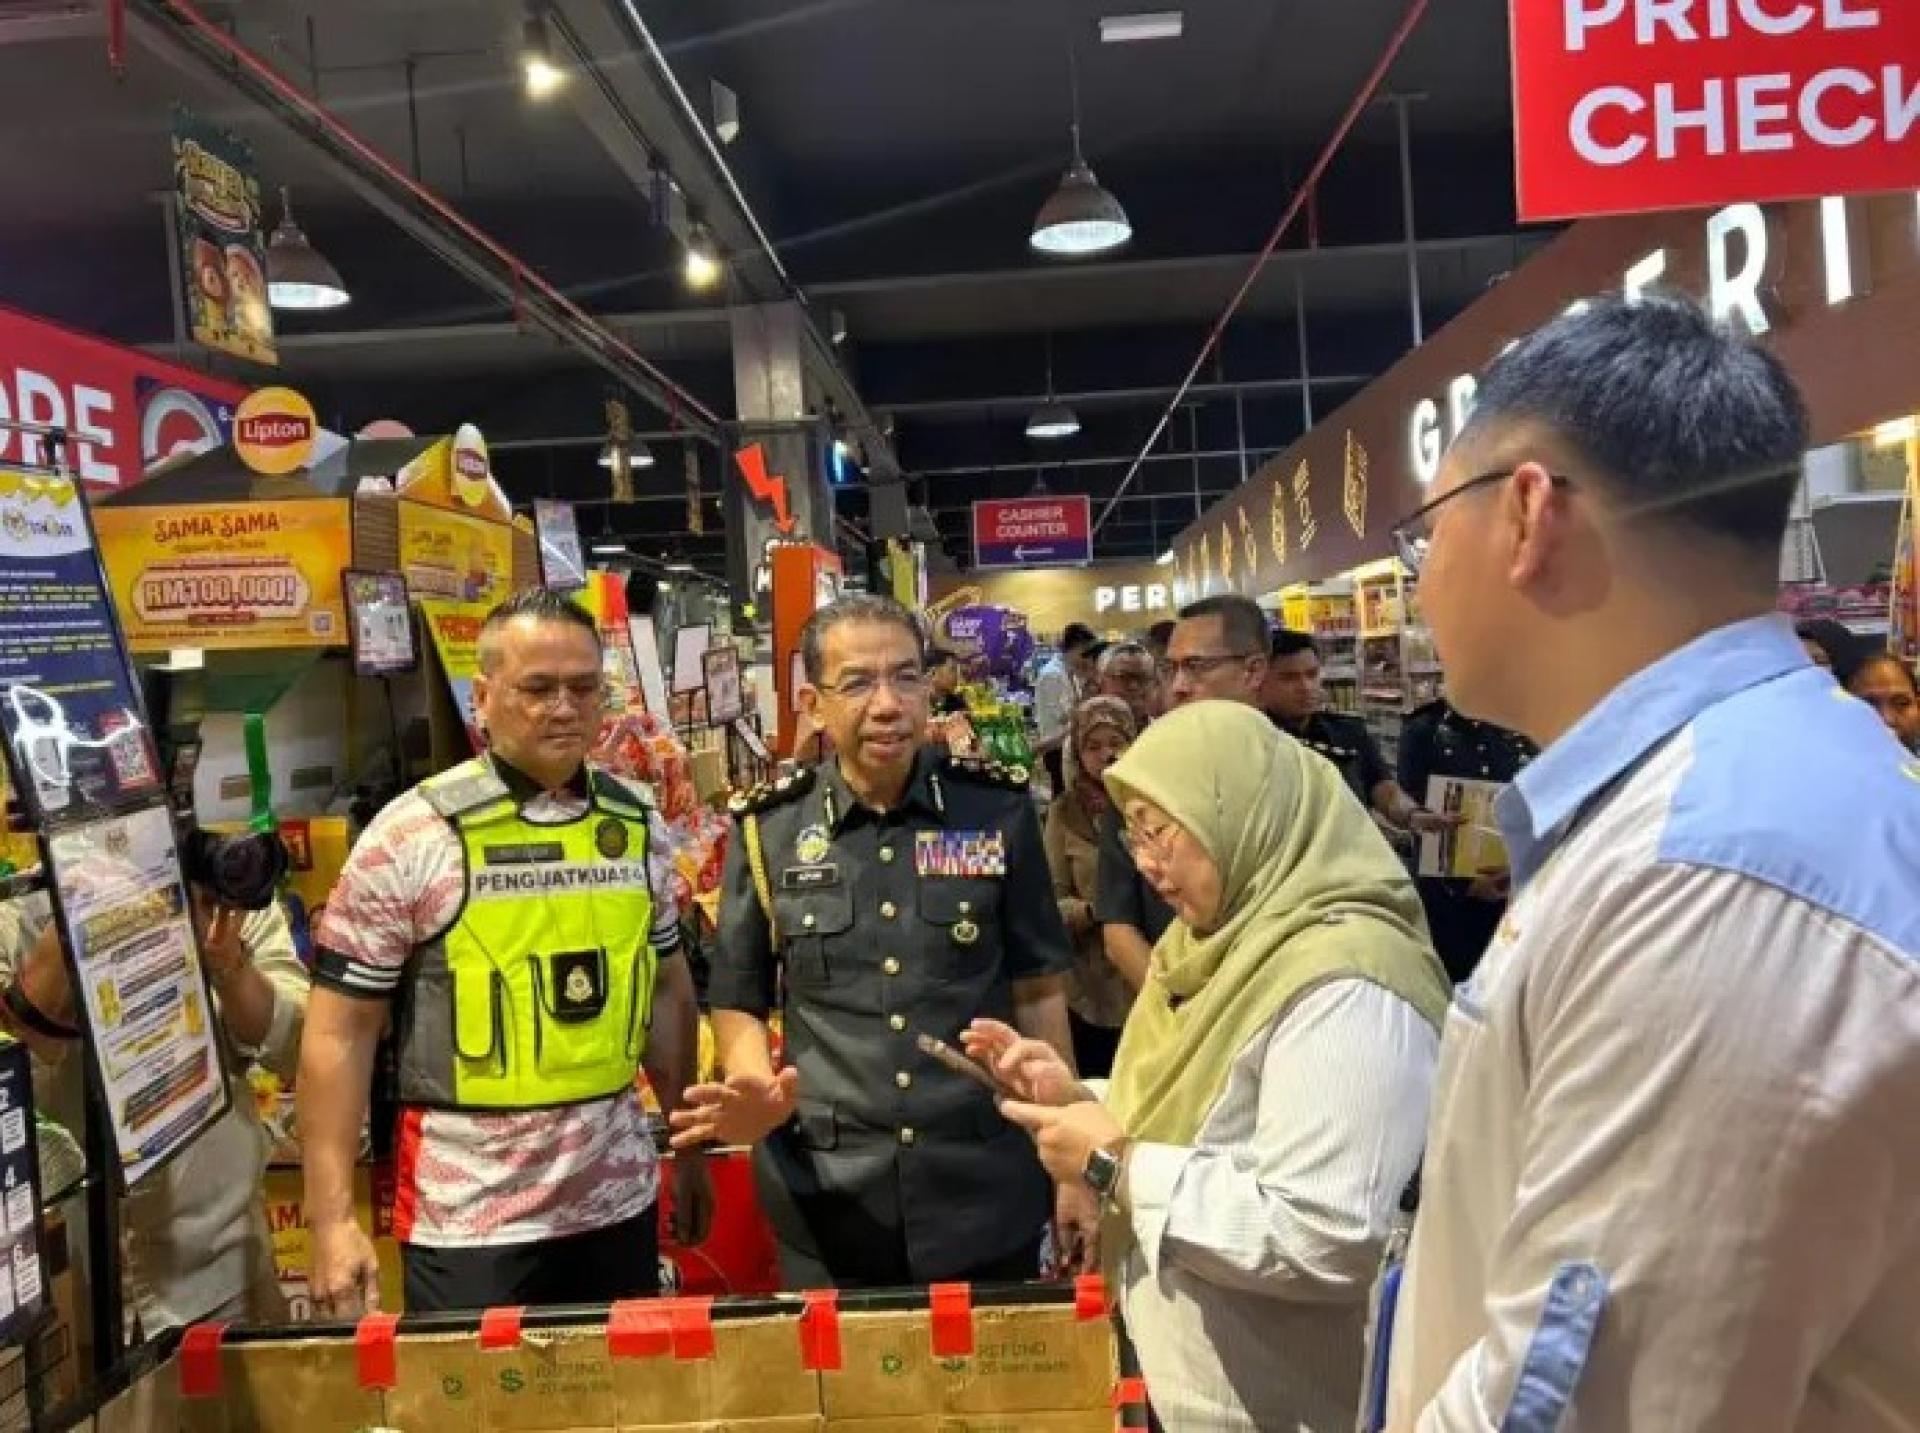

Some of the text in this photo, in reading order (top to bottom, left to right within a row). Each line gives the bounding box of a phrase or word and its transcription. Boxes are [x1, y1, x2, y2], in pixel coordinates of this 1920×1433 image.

[1568, 63, 1920, 166] CHECK
[243, 420, 305, 443] Lipton
[998, 506, 1063, 523] CASHIER
[155, 511, 280, 543] SAMA SAMA
[996, 522, 1068, 538] COUNTER
